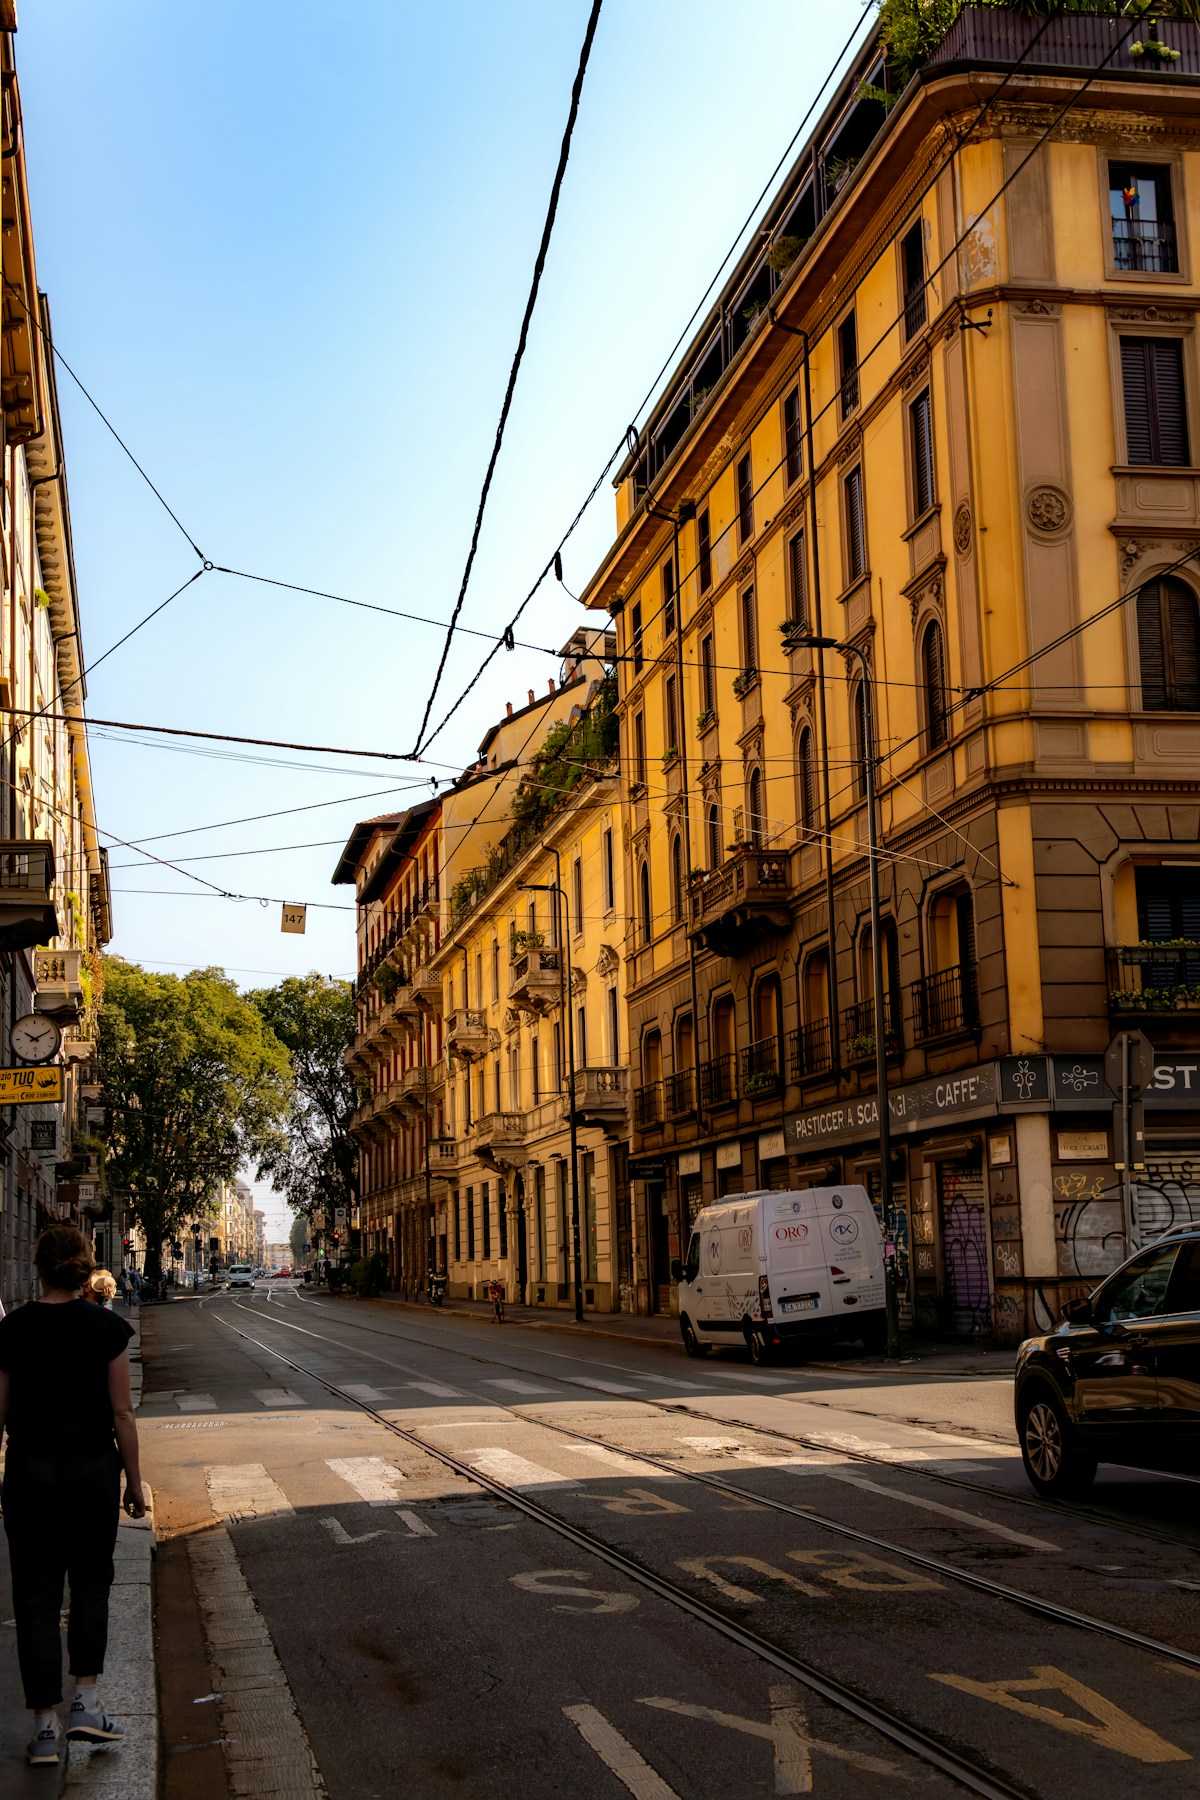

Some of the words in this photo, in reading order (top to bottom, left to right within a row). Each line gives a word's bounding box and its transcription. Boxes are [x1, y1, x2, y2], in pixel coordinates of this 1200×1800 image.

[284, 914, 304, 924] 147
[13, 1070, 35, 1086] TUO
[935, 1075, 980, 1107] CAFFE'
[1146, 1065, 1198, 1090] ST
[32, 1123, 54, 1131] ONLY
[795, 1107, 854, 1139] PASTICCERA
[857, 1094, 906, 1125] SCANGI
[507, 1548, 949, 1616] BUS
[562, 1659, 1200, 1800] AXI
